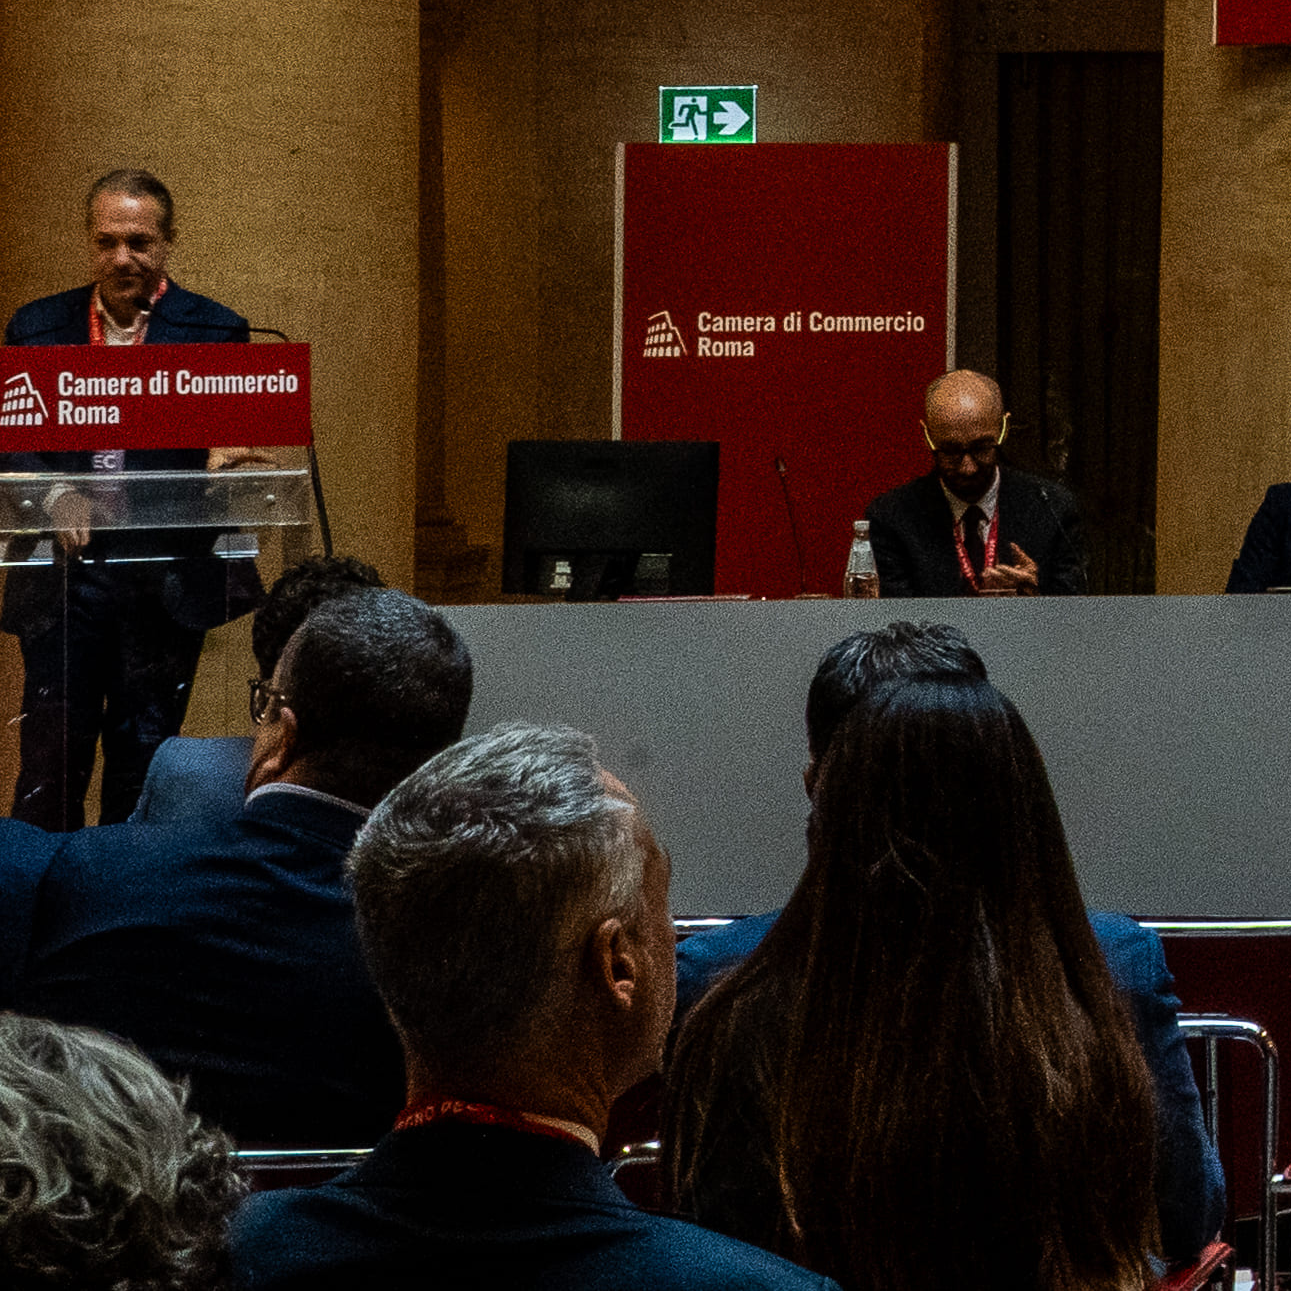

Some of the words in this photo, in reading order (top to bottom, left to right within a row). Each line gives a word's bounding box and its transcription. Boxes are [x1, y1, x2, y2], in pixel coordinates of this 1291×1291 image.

[698, 312, 776, 332] Camera
[783, 311, 801, 332] di
[809, 311, 924, 332] Commercio
[698, 337, 754, 356] Roma
[58, 372, 142, 396] Camera
[149, 370, 168, 395] di
[176, 369, 298, 394] Commercio
[58, 400, 119, 424] Roma
